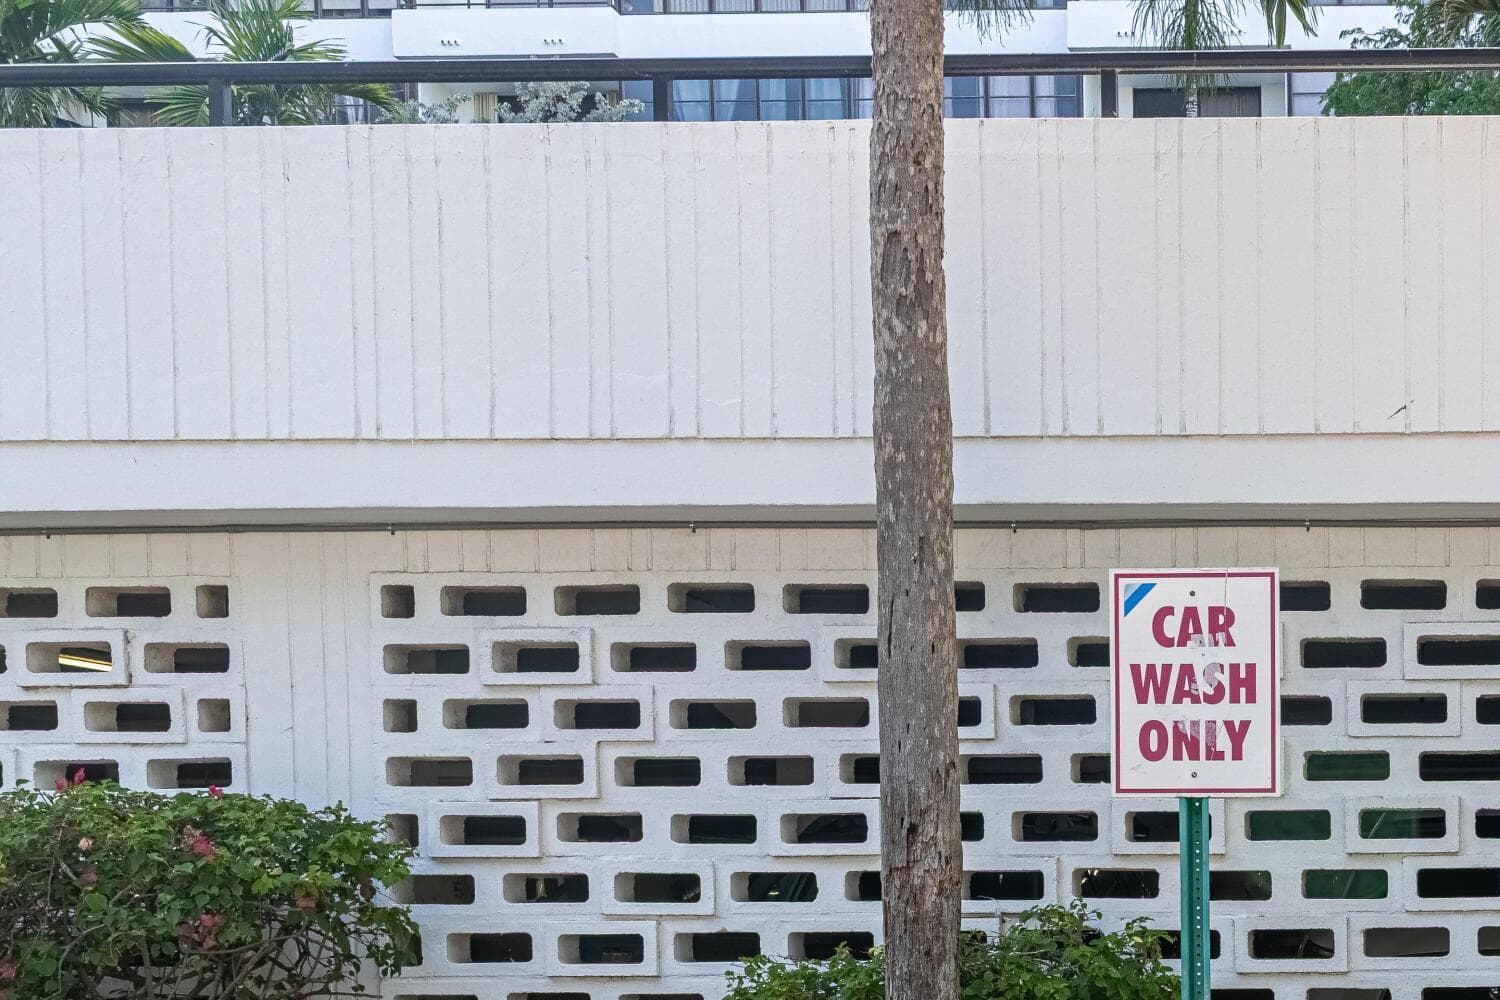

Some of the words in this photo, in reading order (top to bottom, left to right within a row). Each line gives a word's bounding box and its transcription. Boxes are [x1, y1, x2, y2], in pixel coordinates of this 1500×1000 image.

[1151, 605, 1236, 649] CAR
[1129, 662, 1257, 705] WASH
[1138, 719, 1252, 762] ONLY
